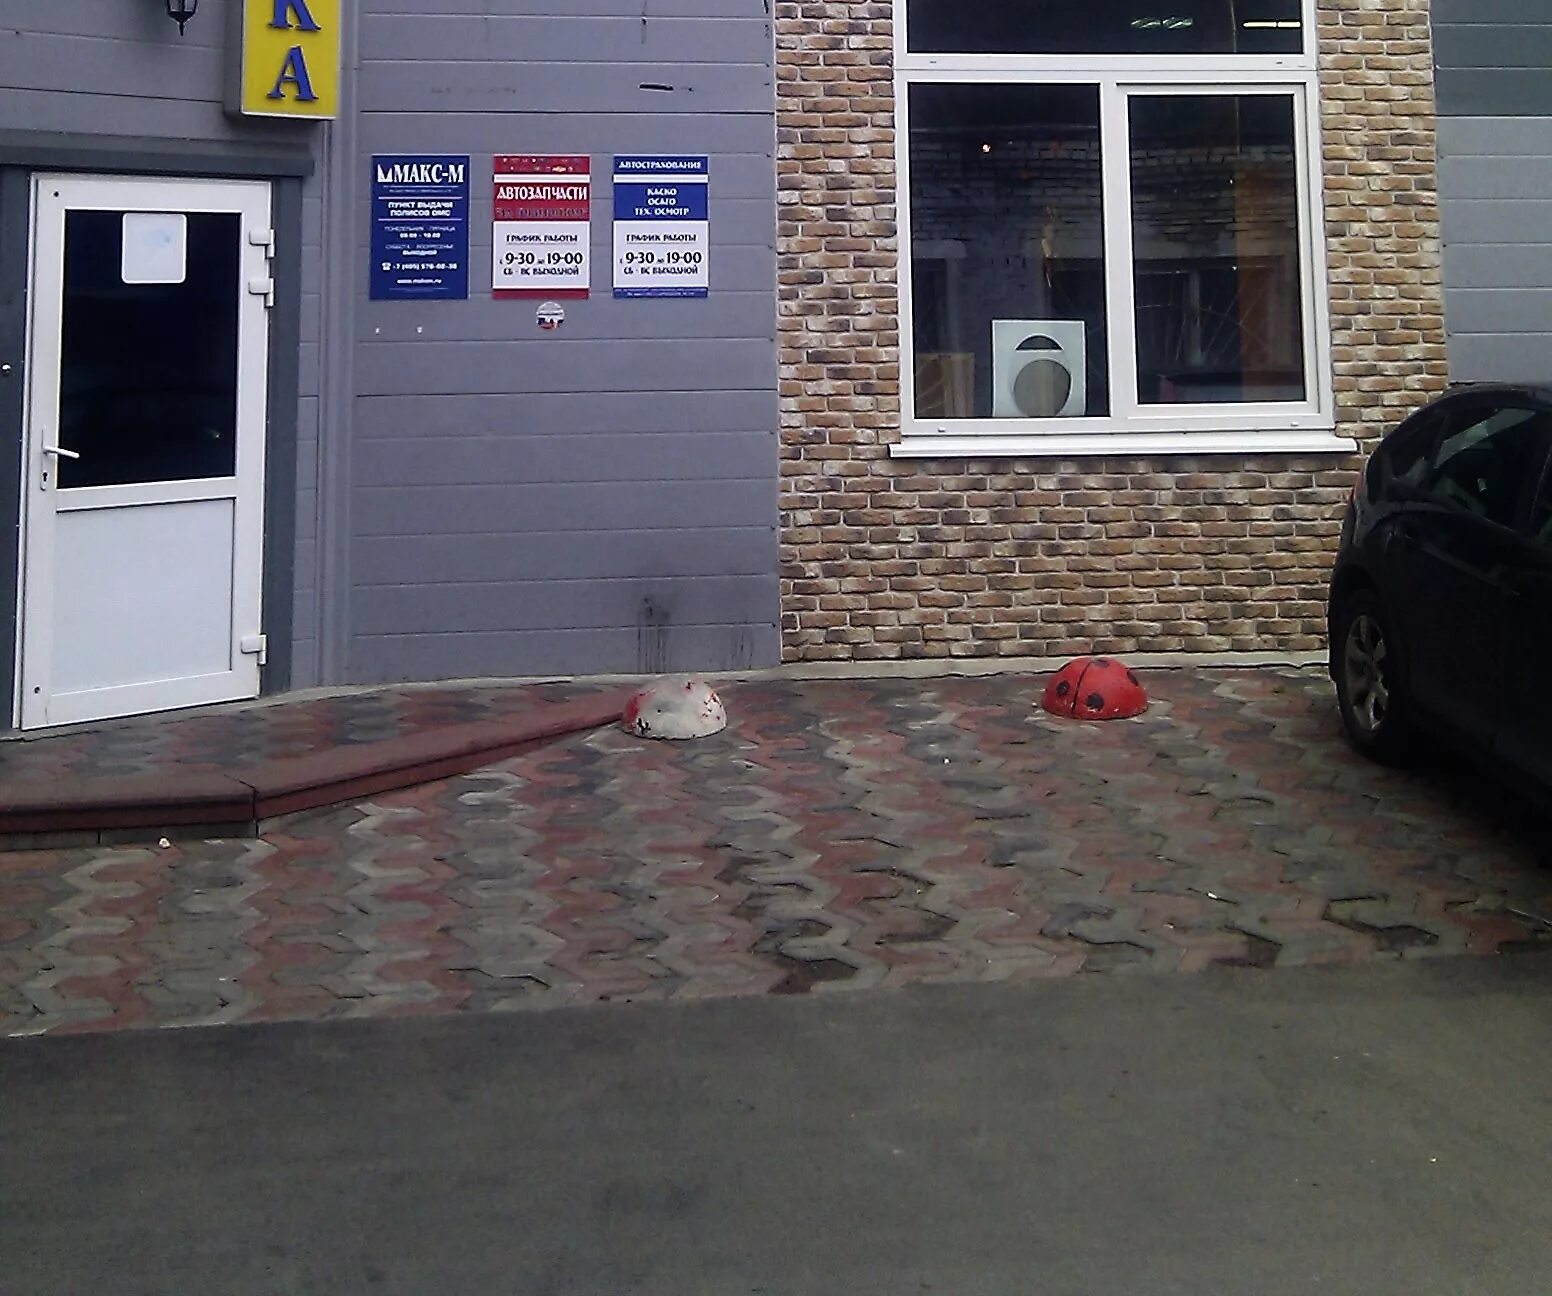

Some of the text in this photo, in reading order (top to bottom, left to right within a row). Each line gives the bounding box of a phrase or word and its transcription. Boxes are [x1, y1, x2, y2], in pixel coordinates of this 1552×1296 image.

[394, 164, 464, 183] МАКС-М
[497, 186, 588, 200] АВТОЗАПЧАСТИ
[505, 252, 535, 265] 9-30
[546, 252, 583, 265] 19-00
[625, 251, 655, 264] 9-30
[666, 251, 702, 264] 19-00
